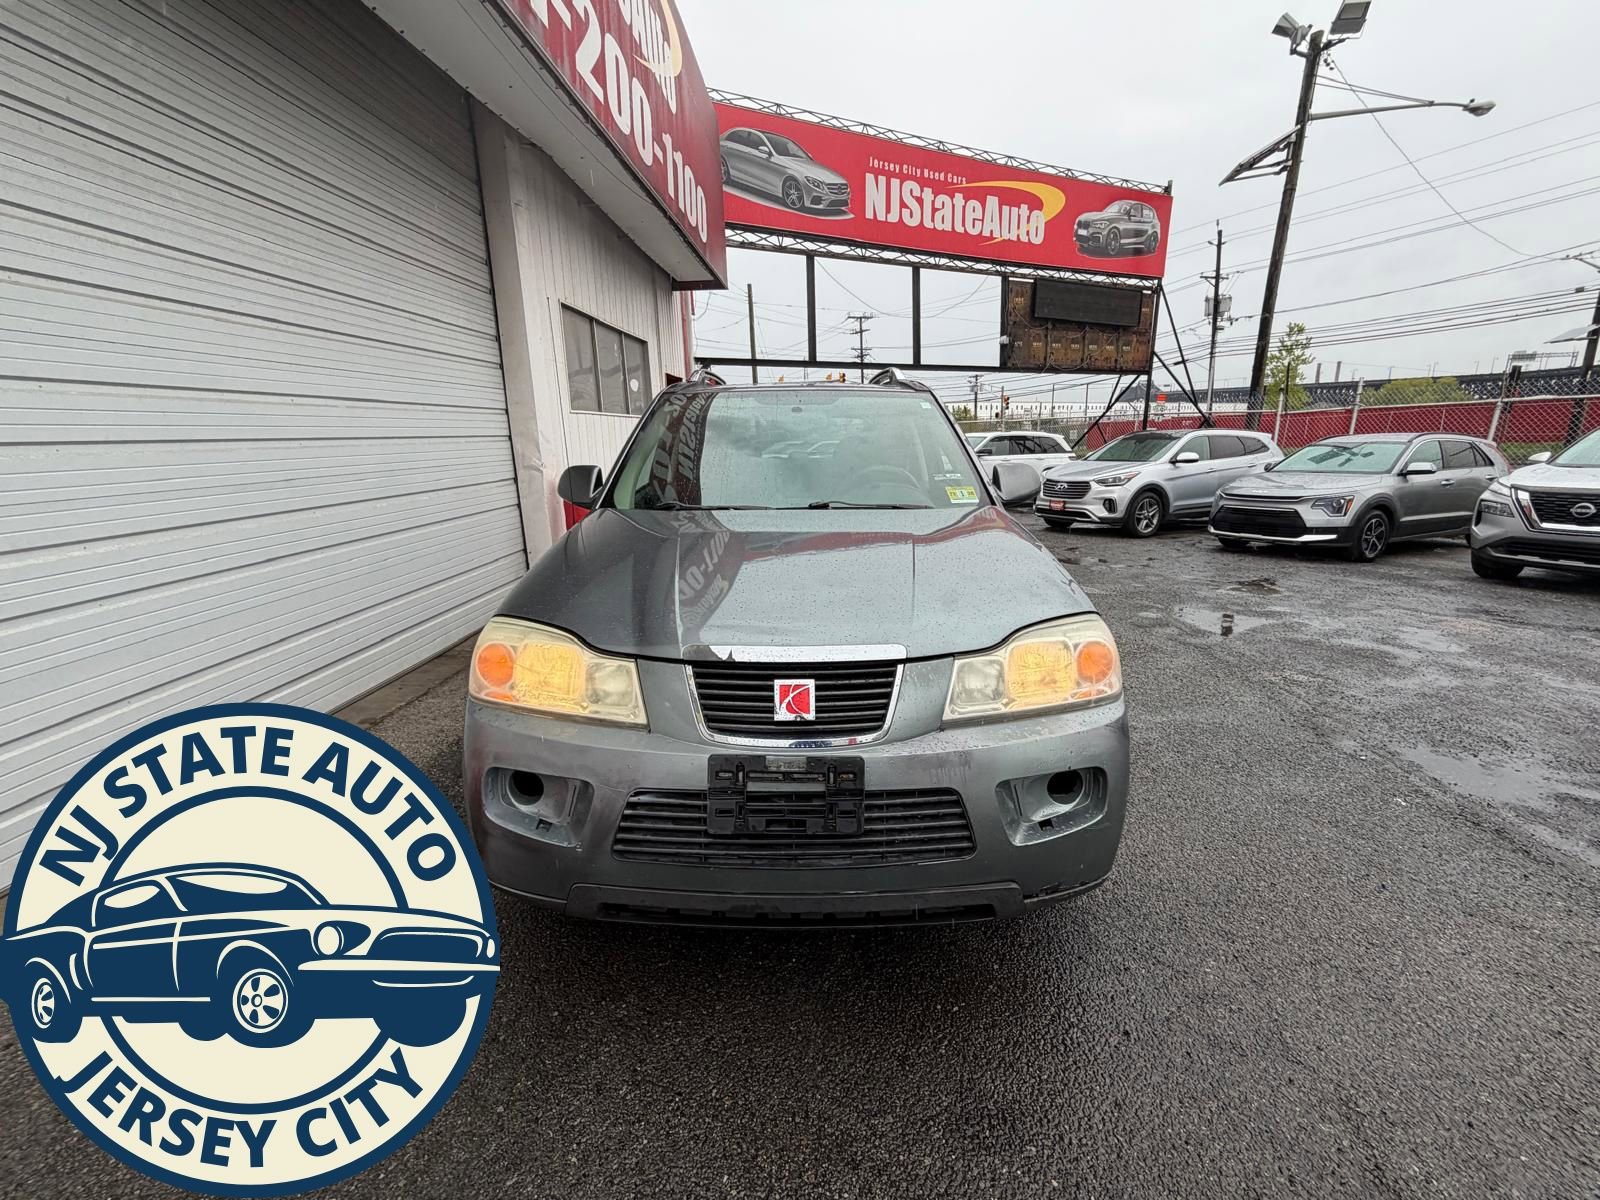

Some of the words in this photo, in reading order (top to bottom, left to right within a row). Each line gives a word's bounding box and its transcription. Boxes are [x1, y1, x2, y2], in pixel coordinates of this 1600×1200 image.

[869, 156, 899, 173] Jersey
[902, 164, 921, 177] City
[923, 168, 945, 181] Used
[947, 172, 967, 185] Cars
[865, 172, 1046, 245] NJStateAuto
